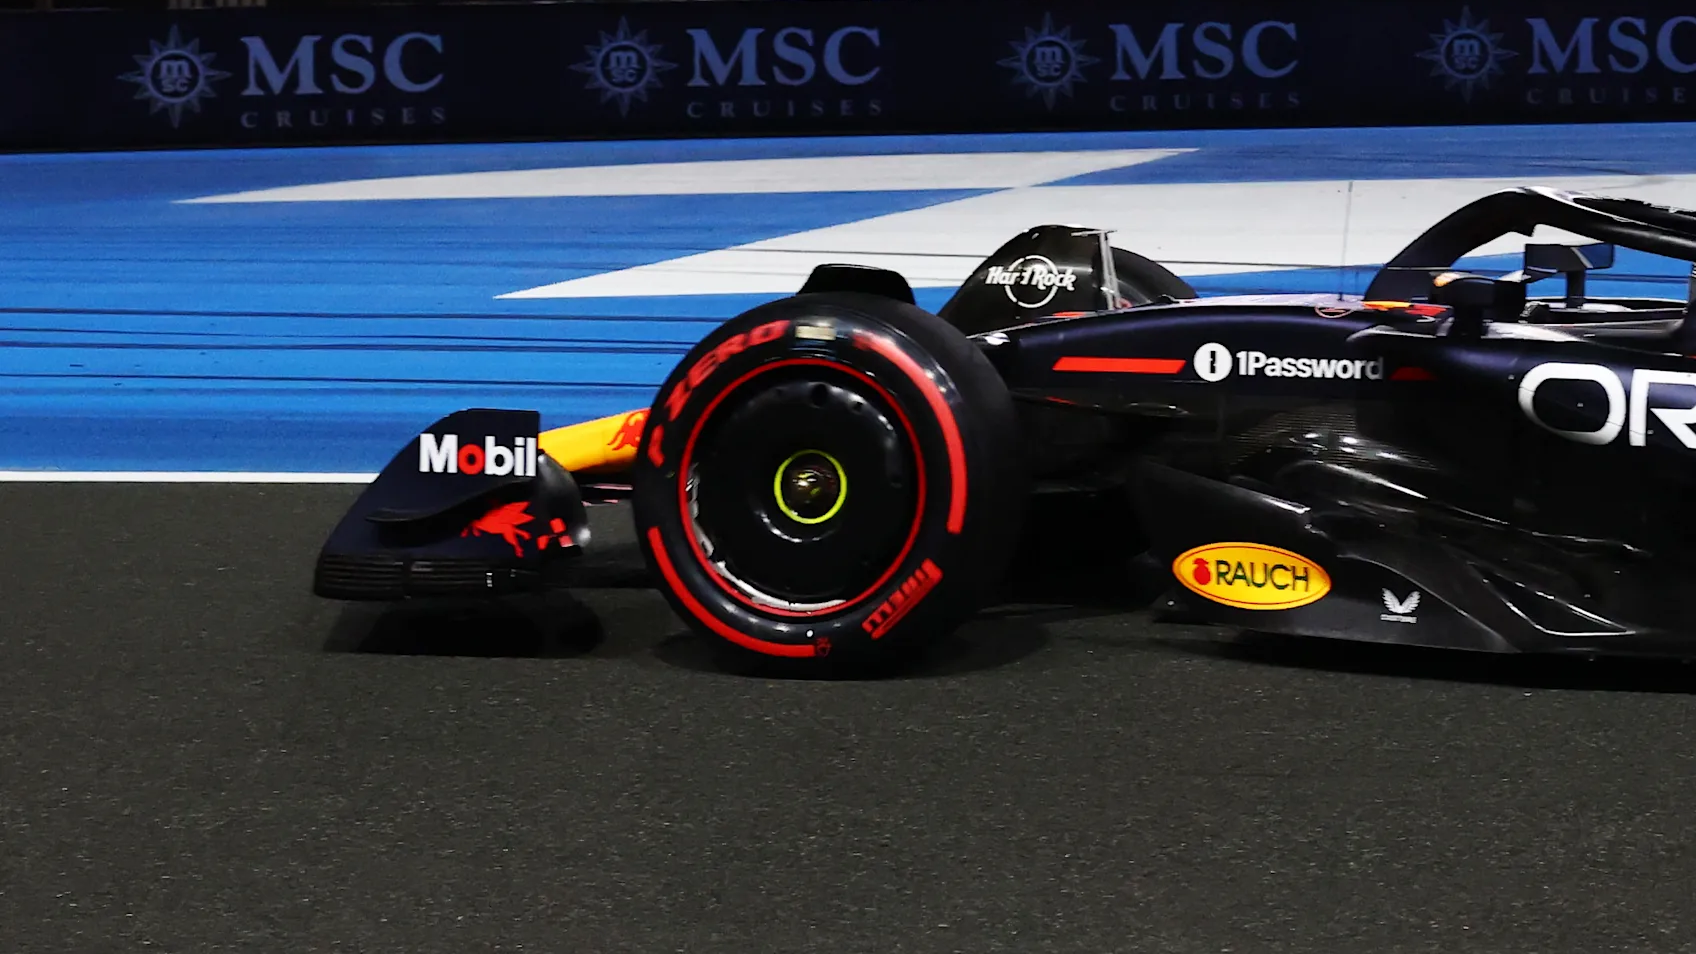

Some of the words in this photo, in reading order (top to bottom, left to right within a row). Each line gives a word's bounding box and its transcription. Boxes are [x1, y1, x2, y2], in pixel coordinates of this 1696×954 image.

[240, 32, 444, 96] MSC
[686, 26, 881, 87] MSC
[1108, 20, 1298, 81] MSC
[240, 107, 446, 129] CRUISES
[686, 99, 882, 119] CRUISES
[1109, 92, 1300, 112] CRUISES
[985, 265, 1034, 285] Hard
[1030, 264, 1077, 291] Rock
[1236, 350, 1384, 381] 1Password
[419, 433, 537, 477] Mobil
[1214, 559, 1310, 592] RAUCH
